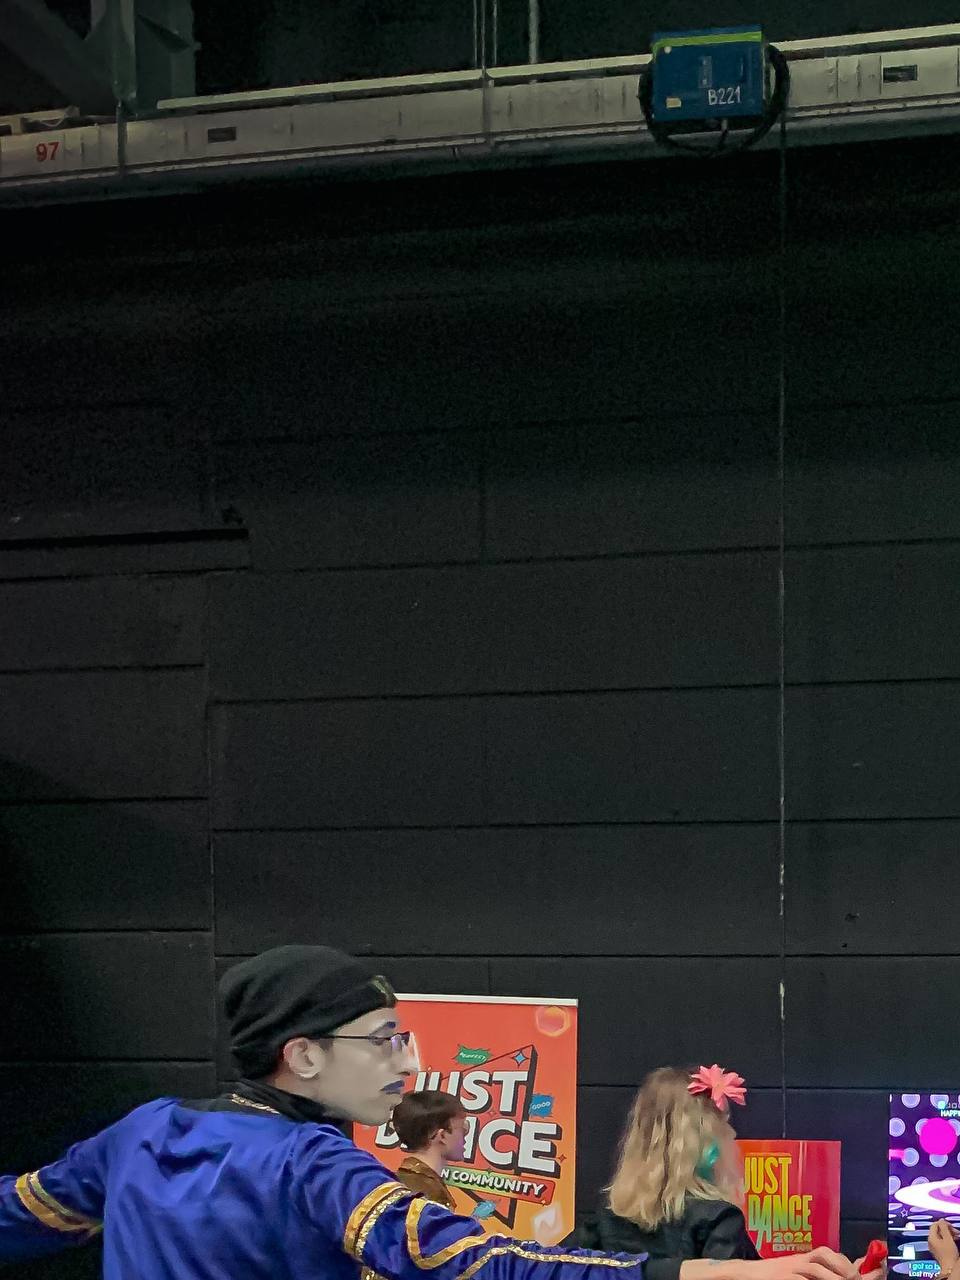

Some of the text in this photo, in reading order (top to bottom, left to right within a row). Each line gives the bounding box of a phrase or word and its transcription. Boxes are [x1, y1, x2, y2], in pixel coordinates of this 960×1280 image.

[708, 86, 741, 106] B221
[36, 142, 60, 162] 97
[452, 1172, 544, 1196] COMMUNITY
[743, 1157, 792, 1195] JUST
[748, 1195, 813, 1251] DANCE
[773, 1232, 812, 1243] 2024
